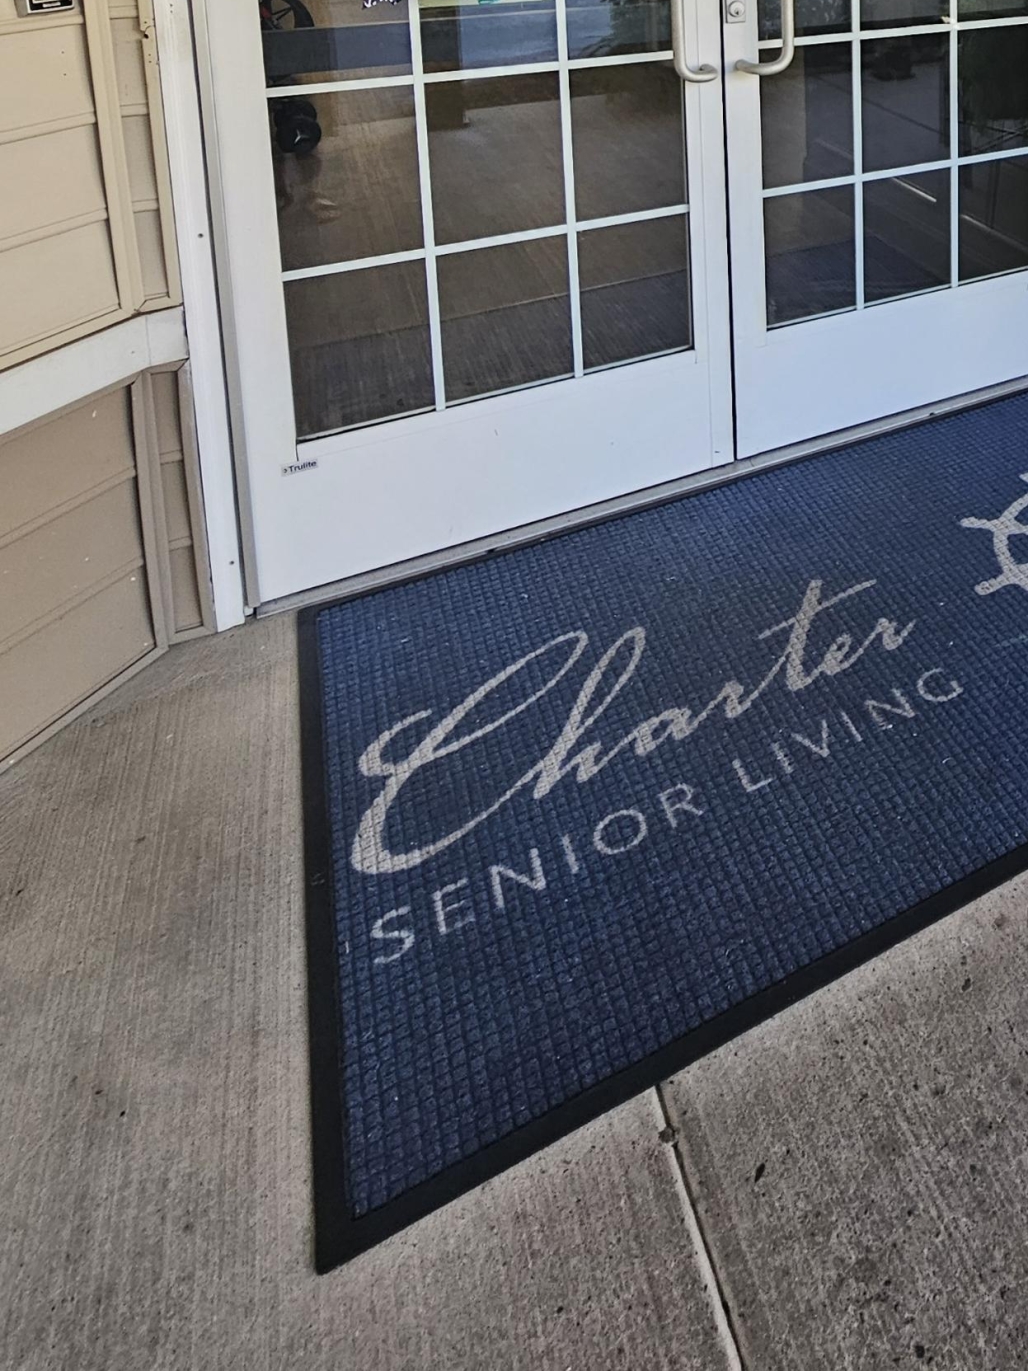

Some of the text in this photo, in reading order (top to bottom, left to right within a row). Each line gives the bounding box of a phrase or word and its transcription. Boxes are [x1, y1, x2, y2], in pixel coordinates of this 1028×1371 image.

[288, 460, 318, 473] Trulite
[351, 579, 916, 873] Charter
[371, 668, 964, 964] SENIOR LIVING
